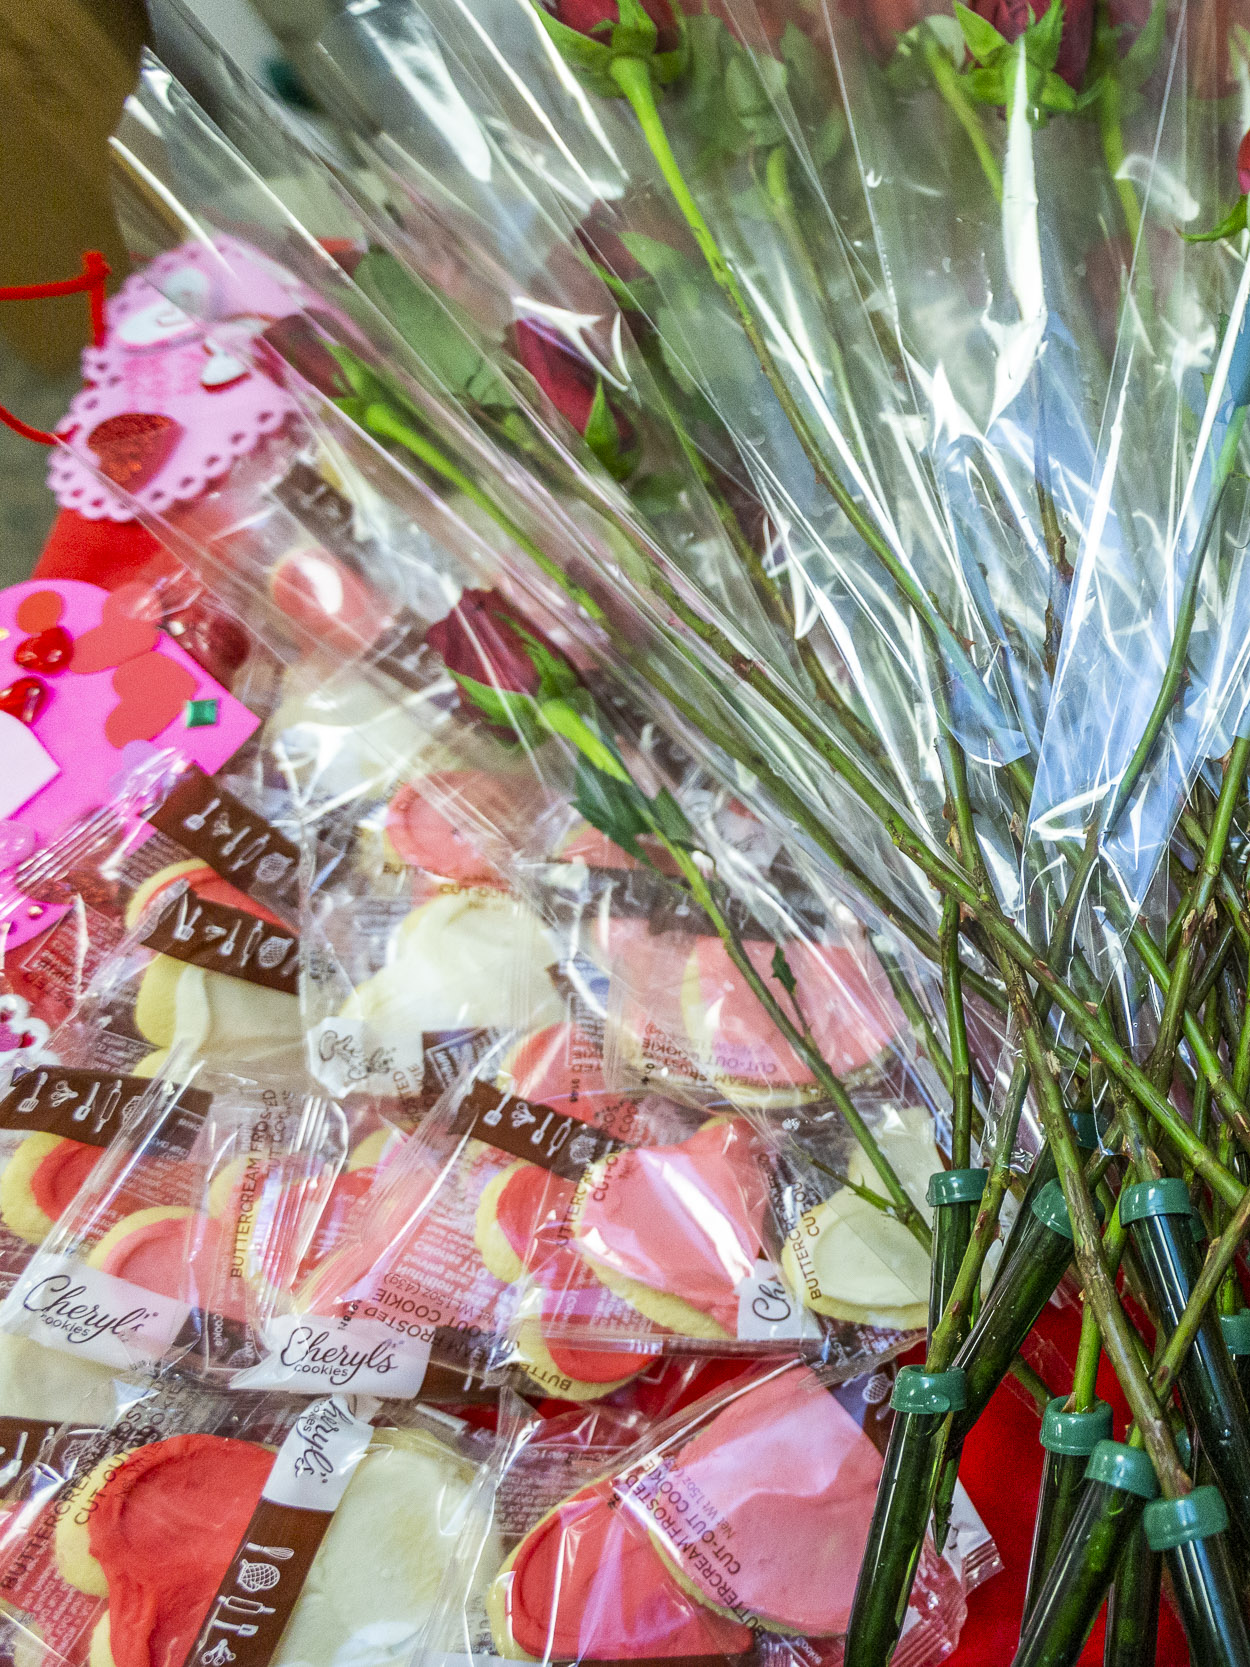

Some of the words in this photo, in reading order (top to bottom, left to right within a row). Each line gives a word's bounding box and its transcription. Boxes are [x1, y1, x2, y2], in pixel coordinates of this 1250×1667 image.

[229, 1157, 262, 1278] BUTTERCREAM
[789, 1179, 821, 1239] CUT-OU
[372, 1287, 441, 1323] COOKIE
[383, 1271, 421, 1295] (43g)
[281, 1327, 398, 1386] Cheryl's
[294, 1362, 348, 1378] cookies
[623, 1471, 683, 1540] FROSTED
[642, 1458, 690, 1514] COOKIE
[700, 1499, 720, 1520] Wt
[686, 1511, 744, 1577] CUT-OUT
[715, 1517, 737, 1540] Net
[677, 1535, 768, 1639] BUTTERCREAM
